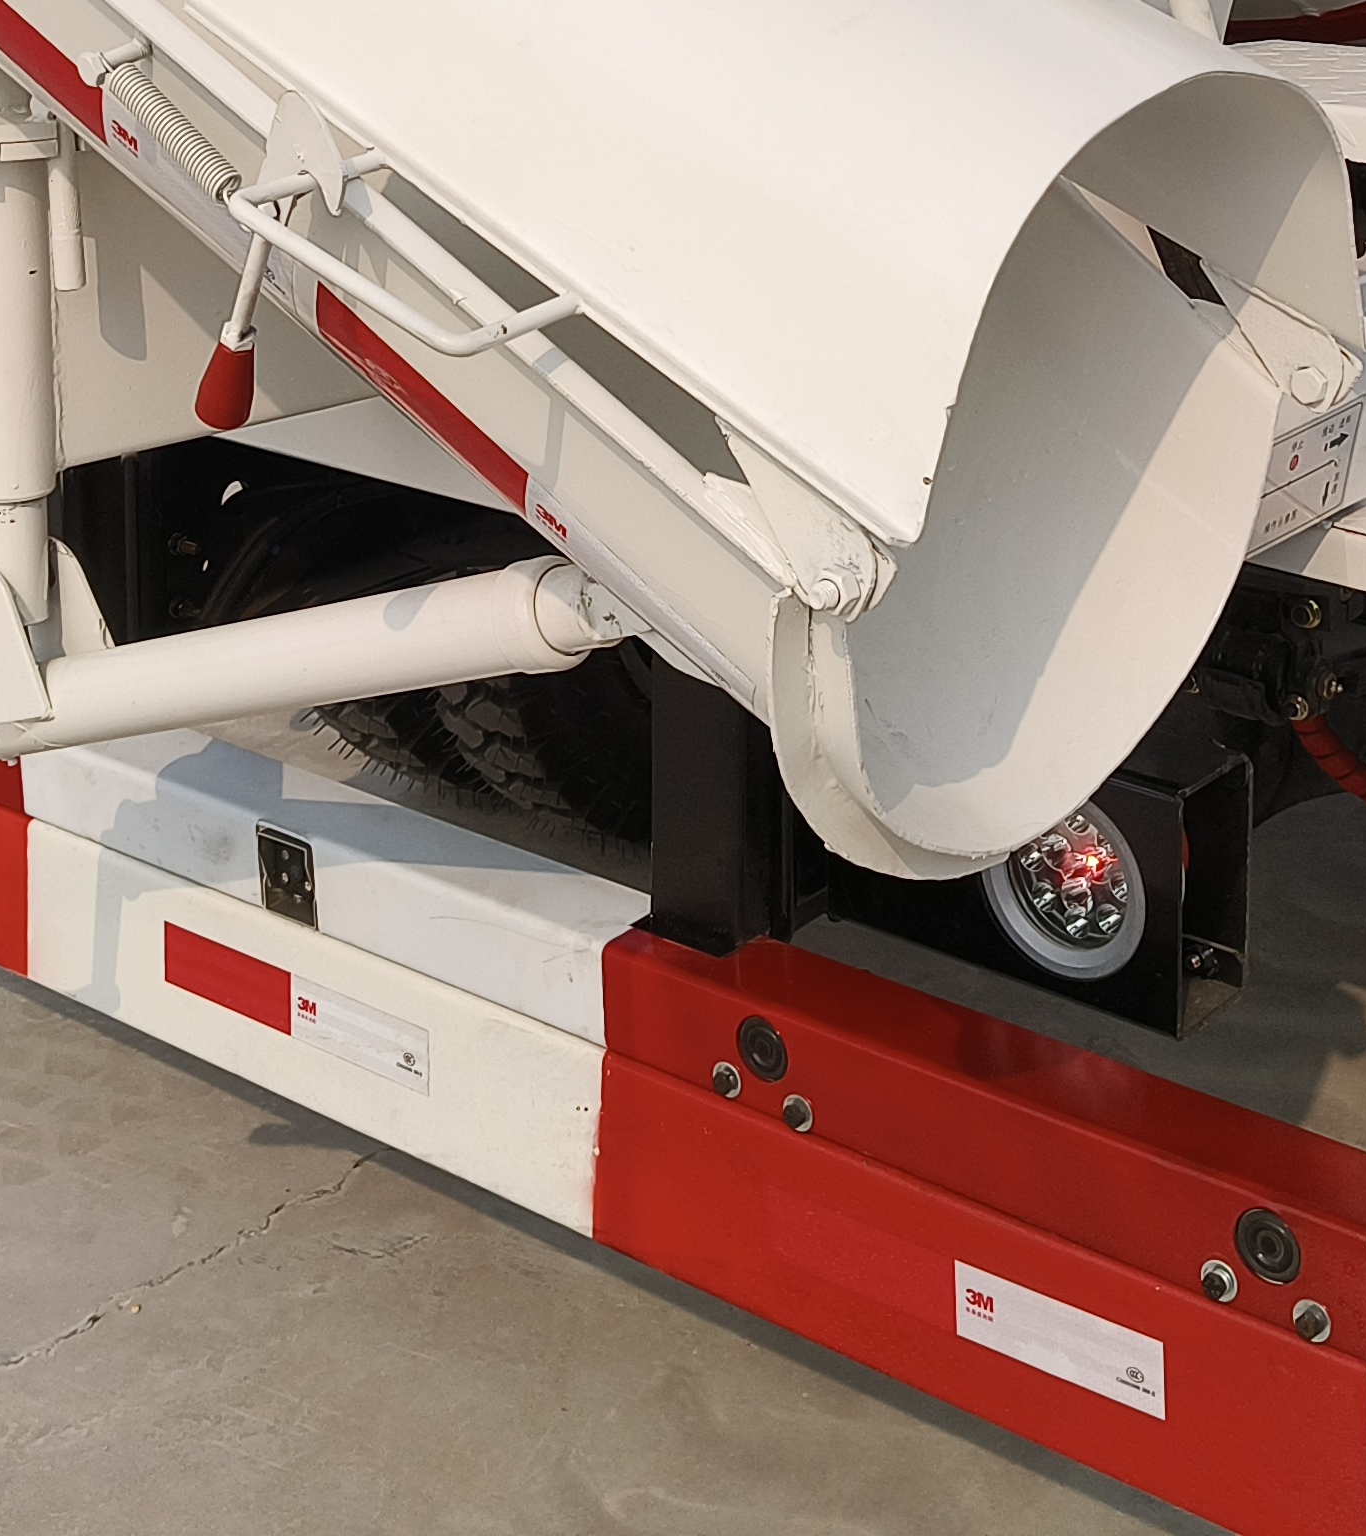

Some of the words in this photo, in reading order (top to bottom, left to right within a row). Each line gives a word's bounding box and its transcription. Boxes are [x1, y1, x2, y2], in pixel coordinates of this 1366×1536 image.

[111, 119, 138, 152] 3M
[536, 503, 567, 539] 3M
[297, 996, 317, 1016] 3M
[965, 1288, 994, 1314] 3M
